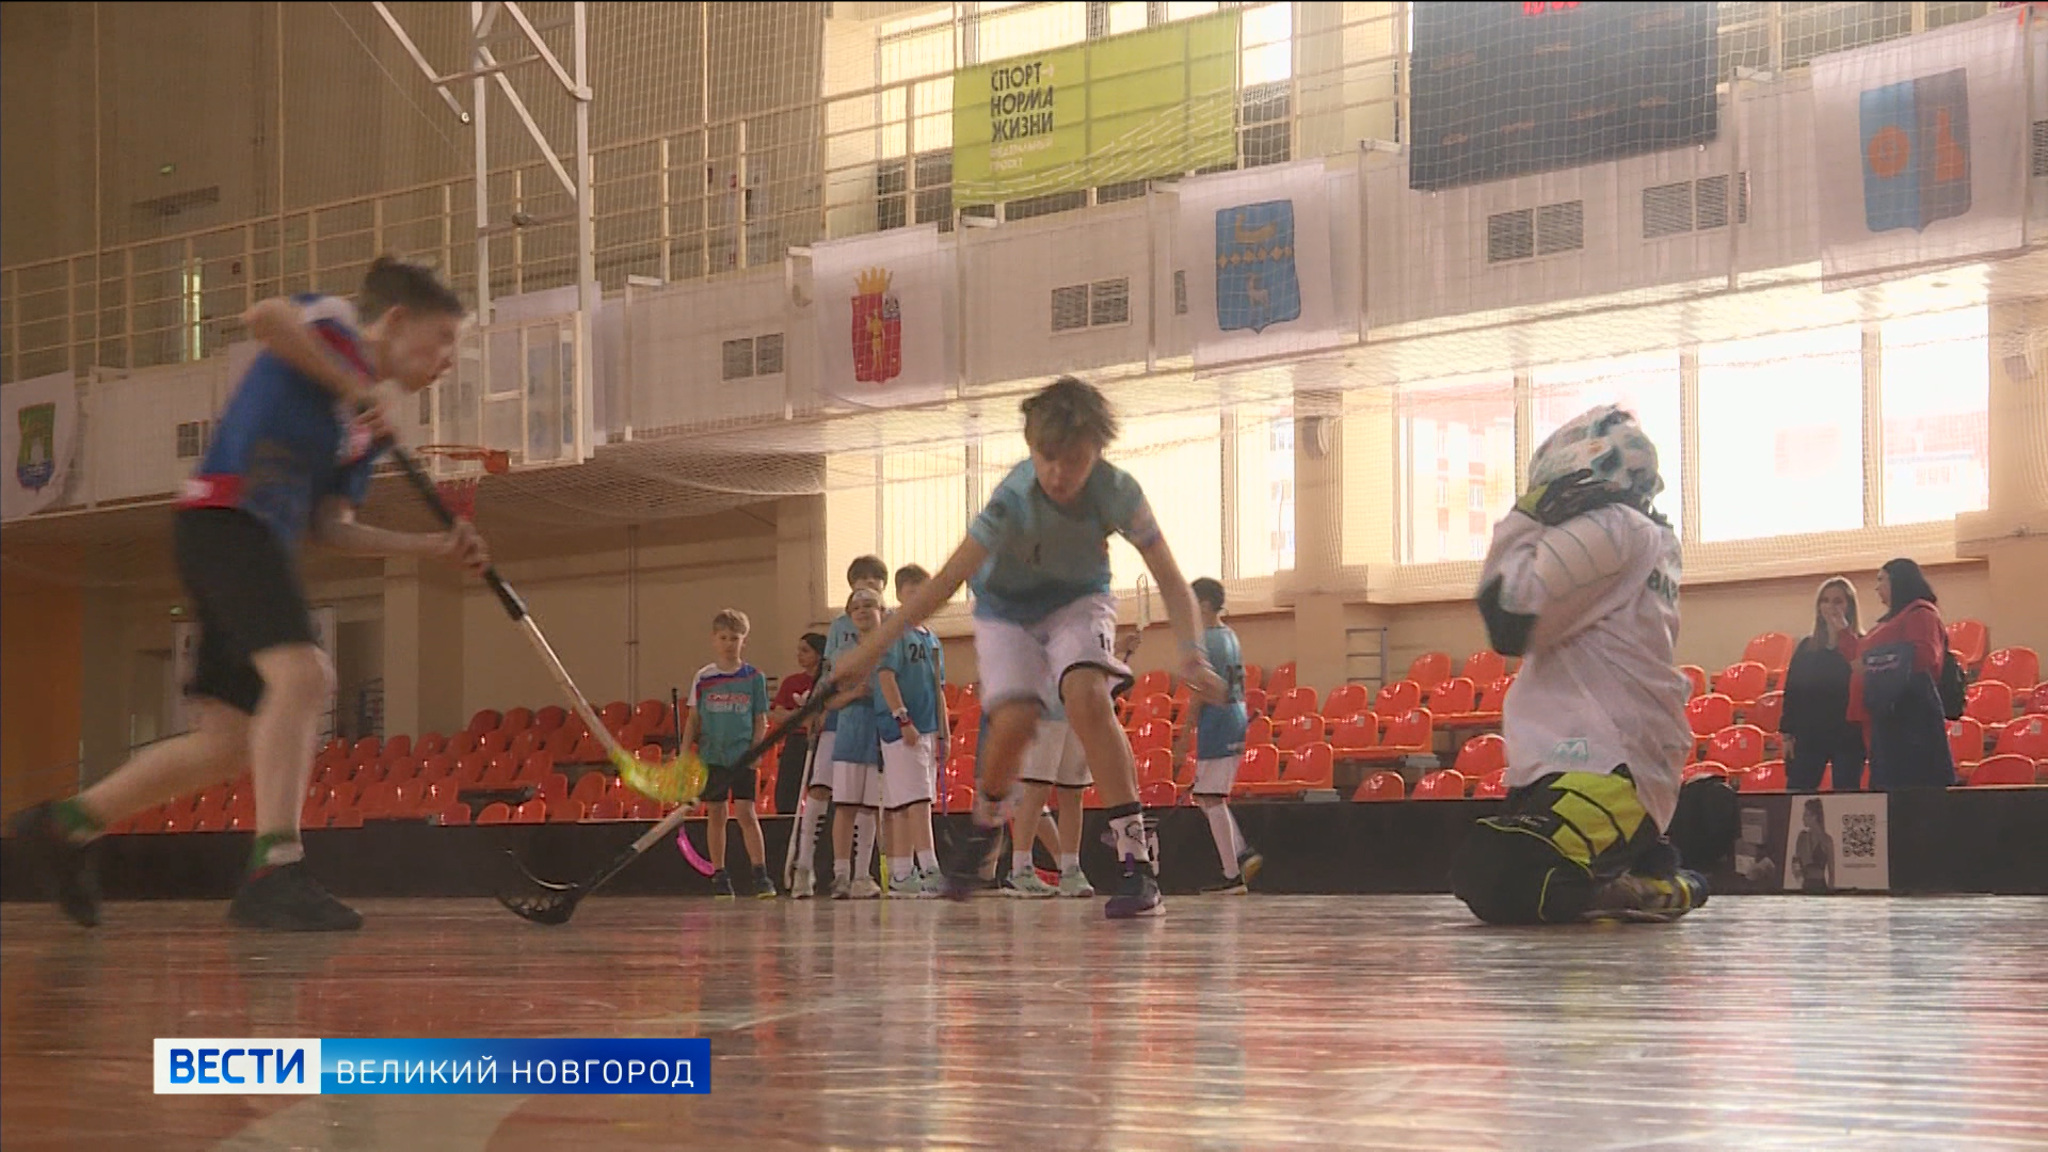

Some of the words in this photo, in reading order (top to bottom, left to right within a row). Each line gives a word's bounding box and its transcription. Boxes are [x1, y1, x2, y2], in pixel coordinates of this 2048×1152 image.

[991, 62, 1042, 91] СПОРТ
[991, 85, 1053, 118] НОРМА
[991, 111, 1053, 142] ЖИЗНИ
[908, 643, 926, 663] 24
